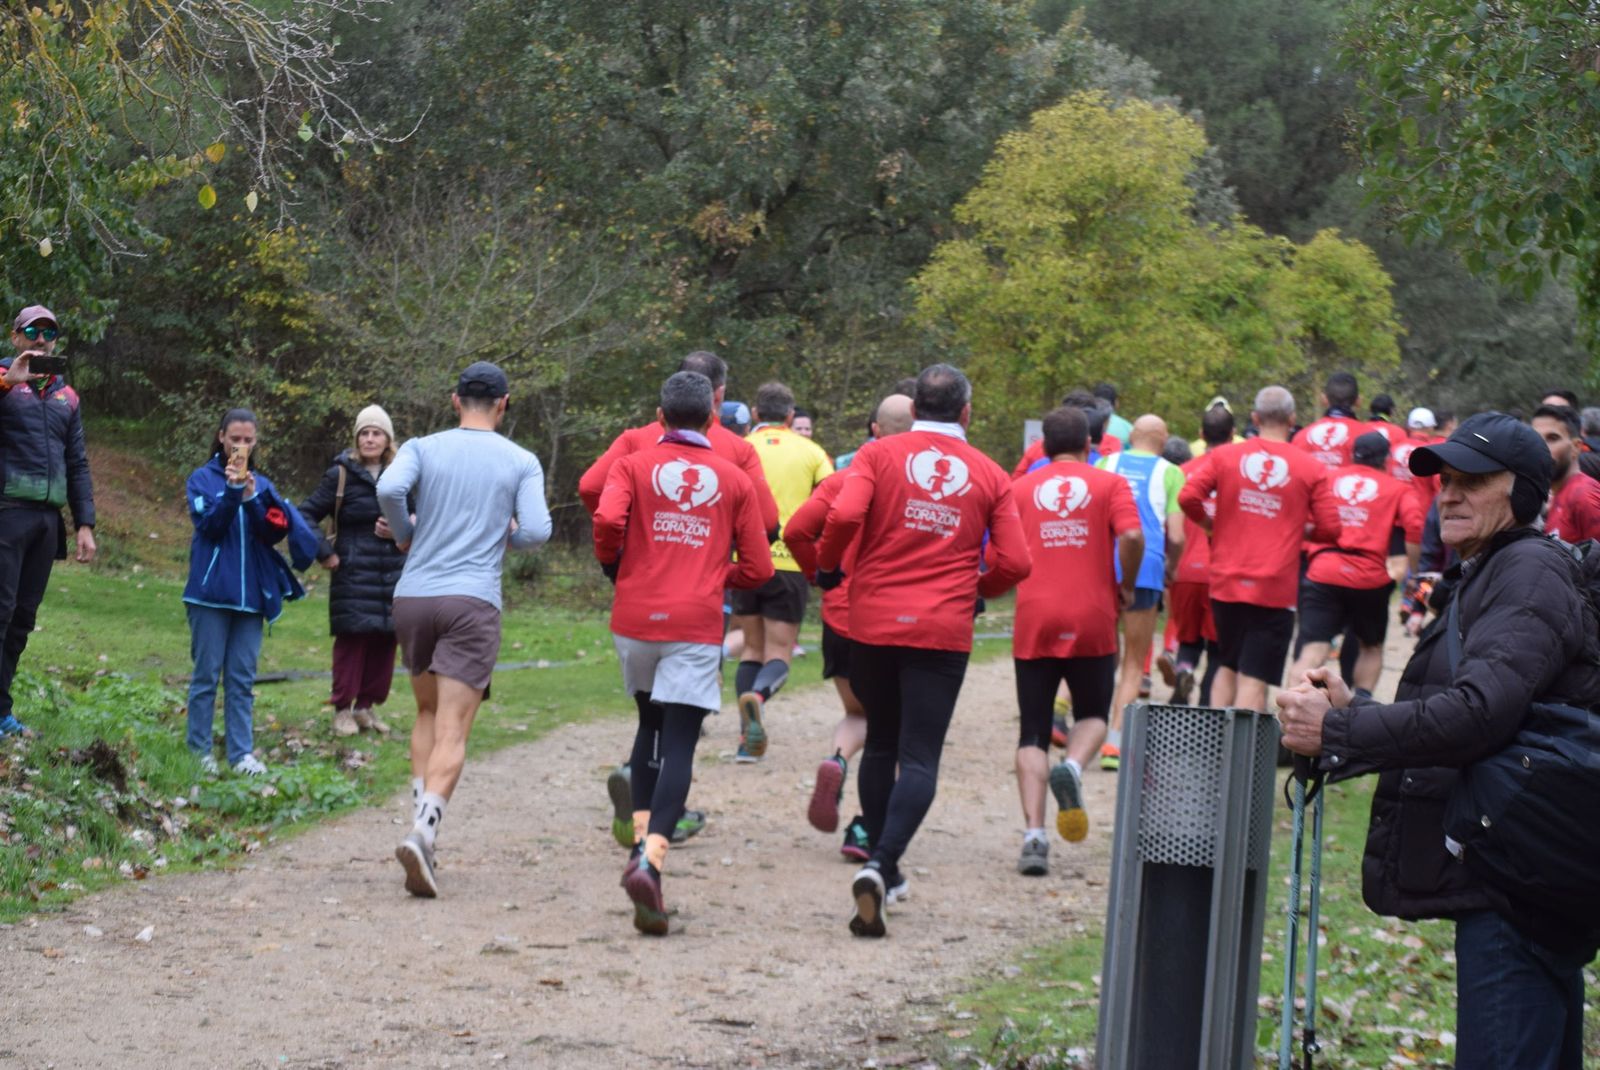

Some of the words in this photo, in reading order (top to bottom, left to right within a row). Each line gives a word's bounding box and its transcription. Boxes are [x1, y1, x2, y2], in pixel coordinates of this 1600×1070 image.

[905, 506, 961, 528] CORAZÓN
[653, 519, 710, 537] CORAZÓN
[1040, 526, 1088, 539] CORAZÓN
